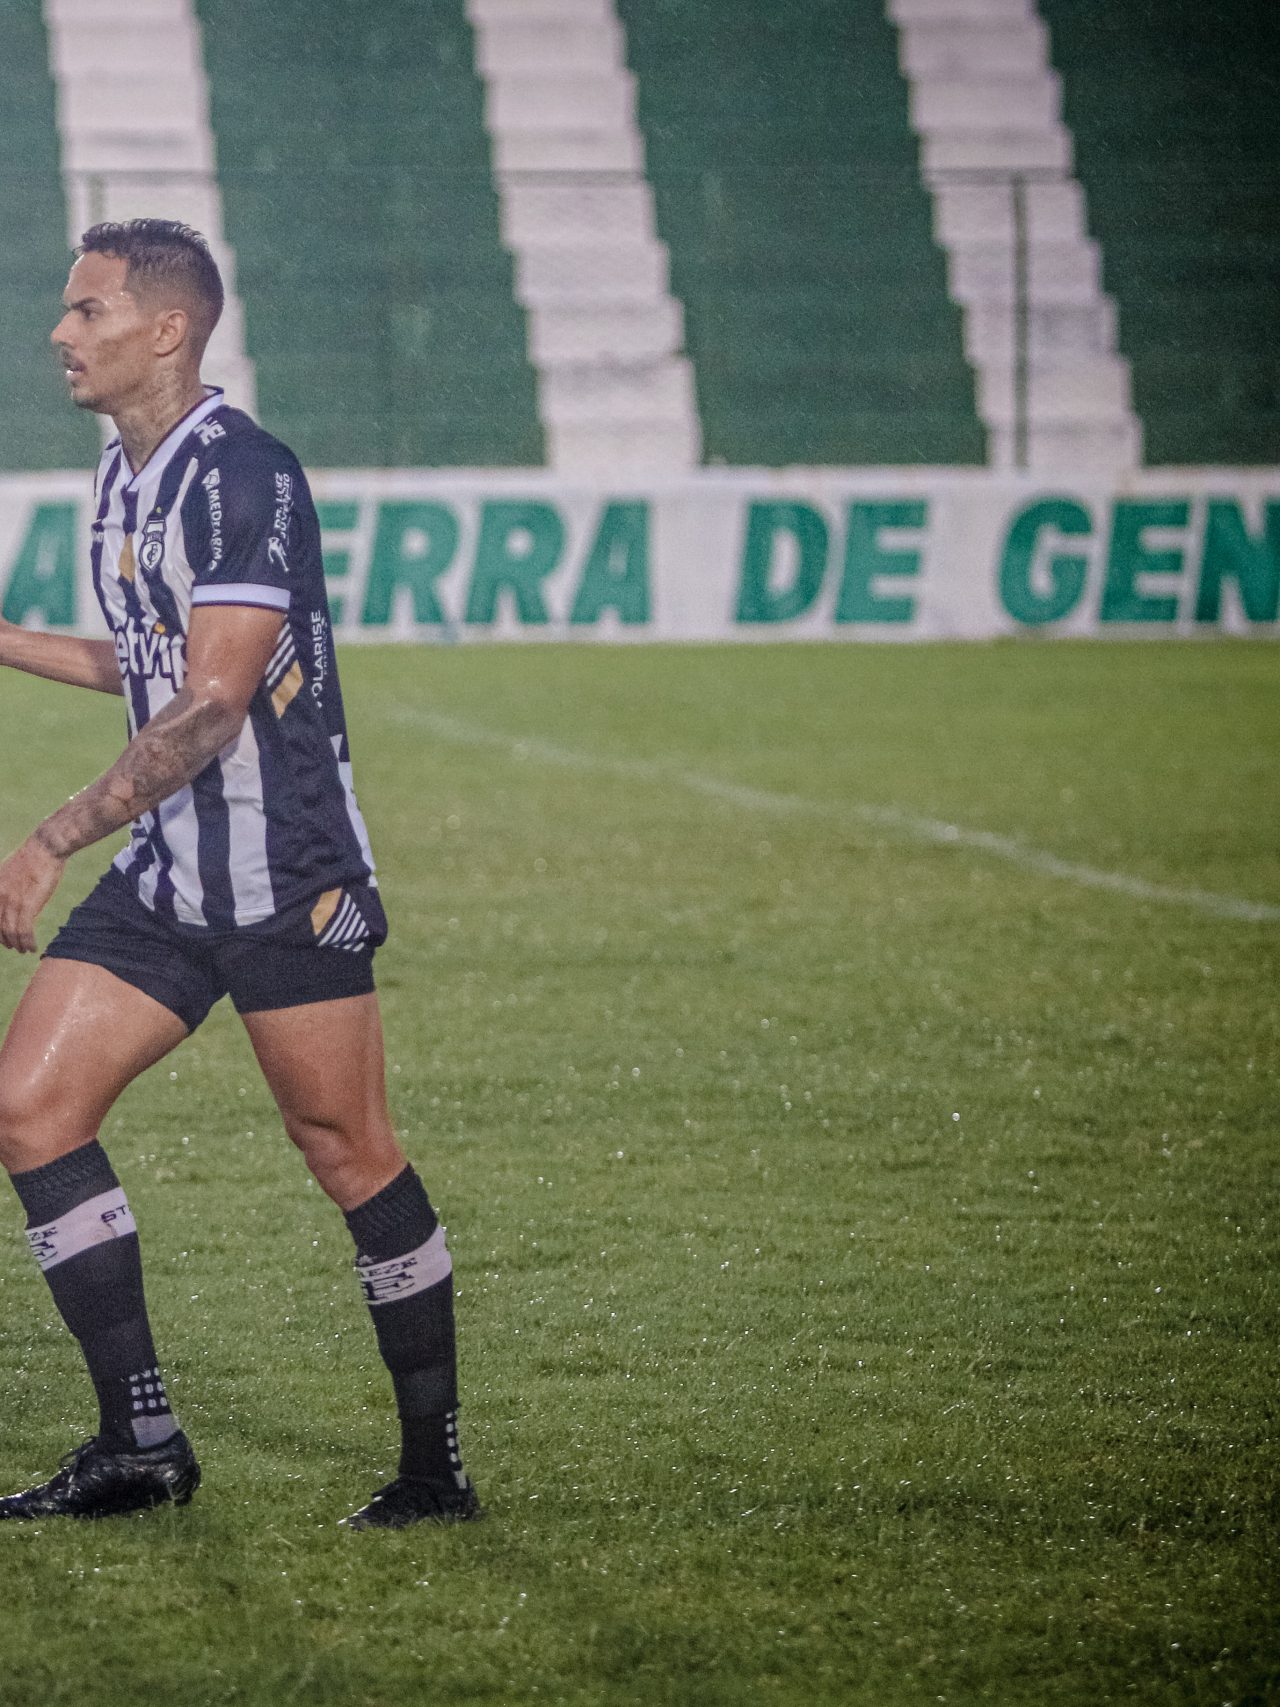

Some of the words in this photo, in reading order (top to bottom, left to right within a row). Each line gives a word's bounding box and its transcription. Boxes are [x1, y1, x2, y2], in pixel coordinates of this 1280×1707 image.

[318, 498, 651, 627] ERRA
[734, 499, 926, 624] DE
[997, 496, 1280, 625] GEN
[311, 609, 324, 708] OLARISE
